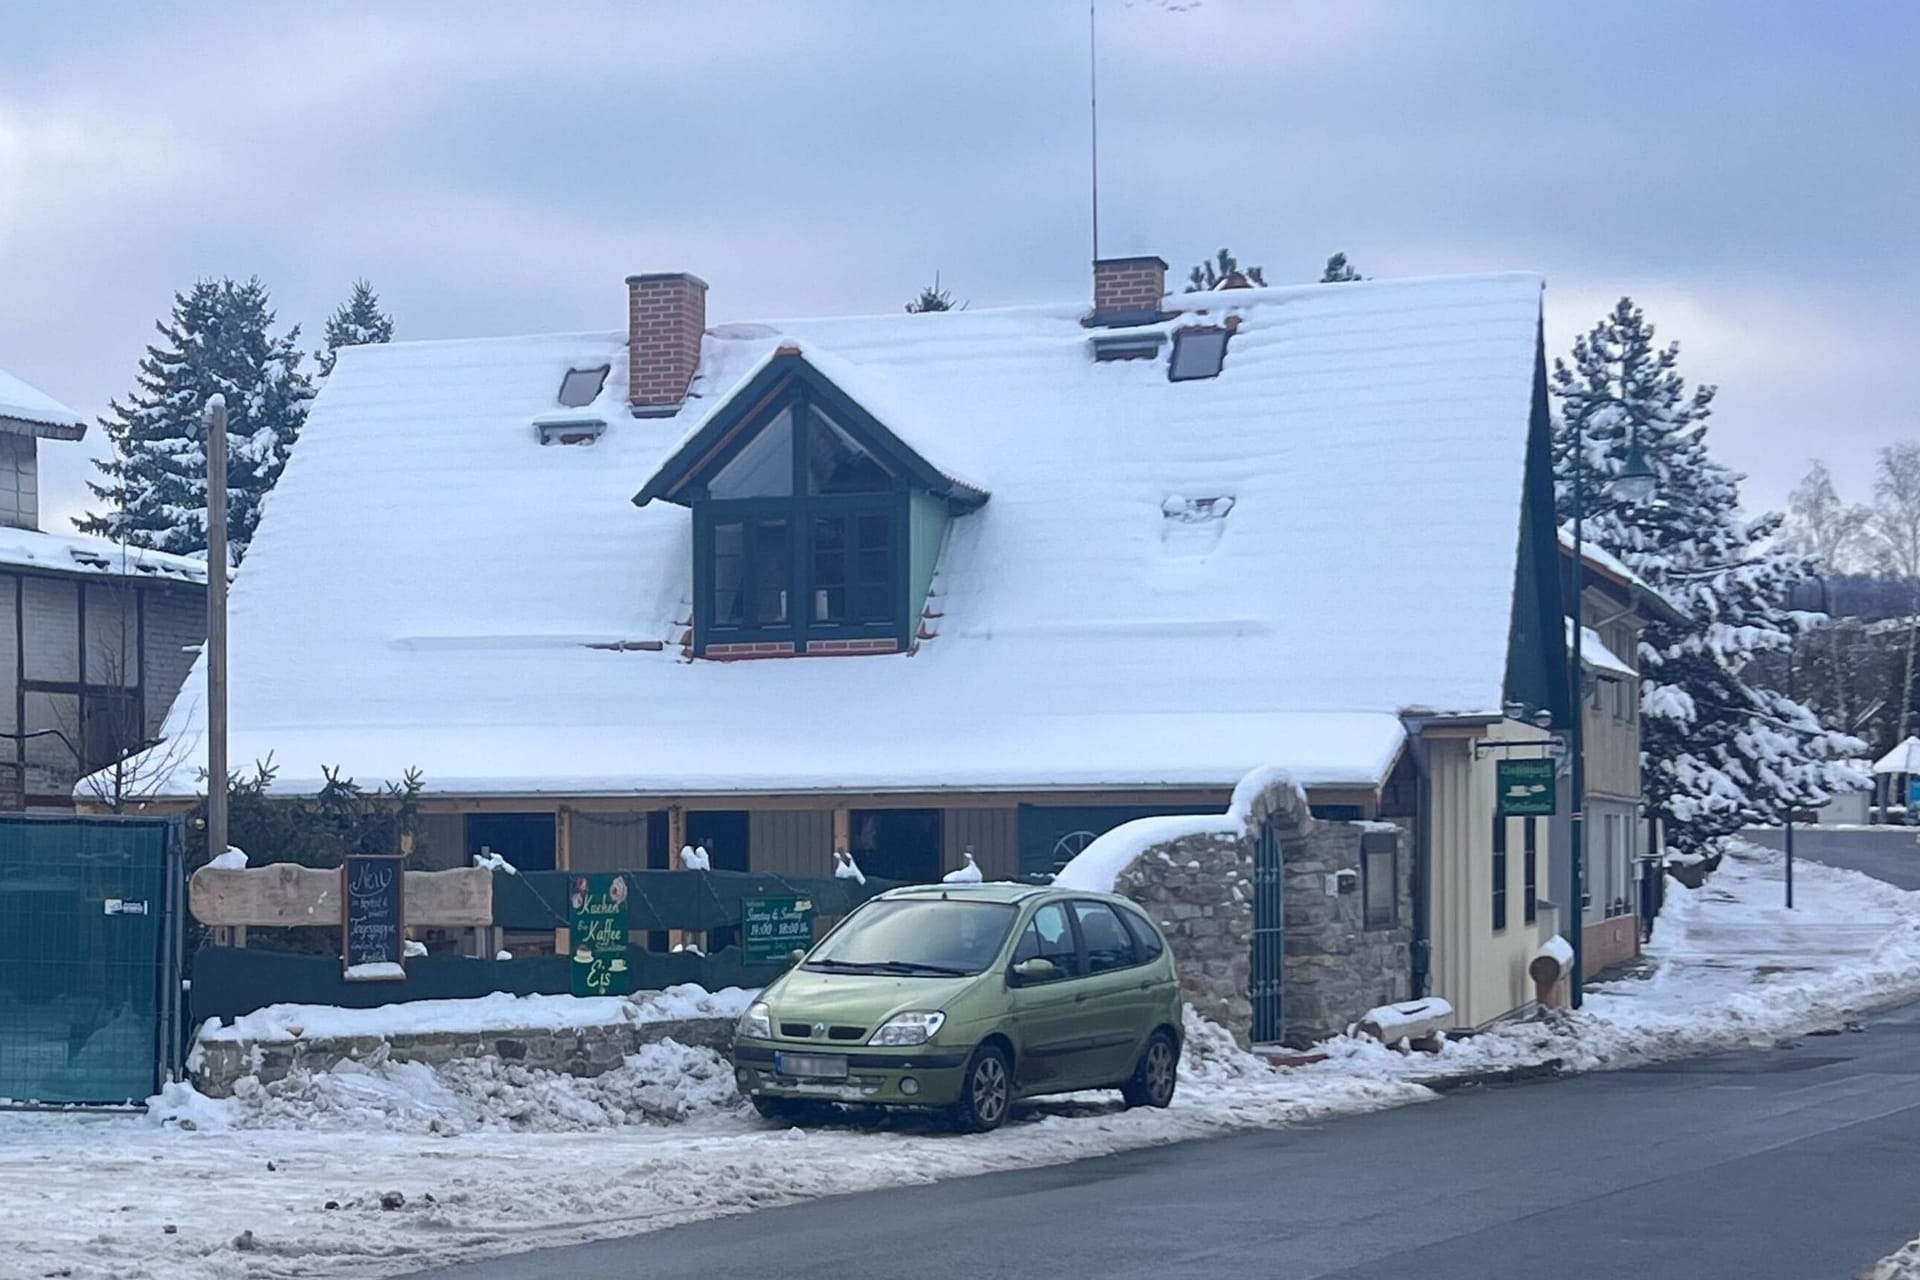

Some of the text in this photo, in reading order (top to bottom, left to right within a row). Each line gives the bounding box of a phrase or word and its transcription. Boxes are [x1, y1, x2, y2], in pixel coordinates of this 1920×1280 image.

[577, 893, 620, 915] Kuchen
[582, 918, 622, 946] Kaffee
[586, 960, 612, 987] Eis
